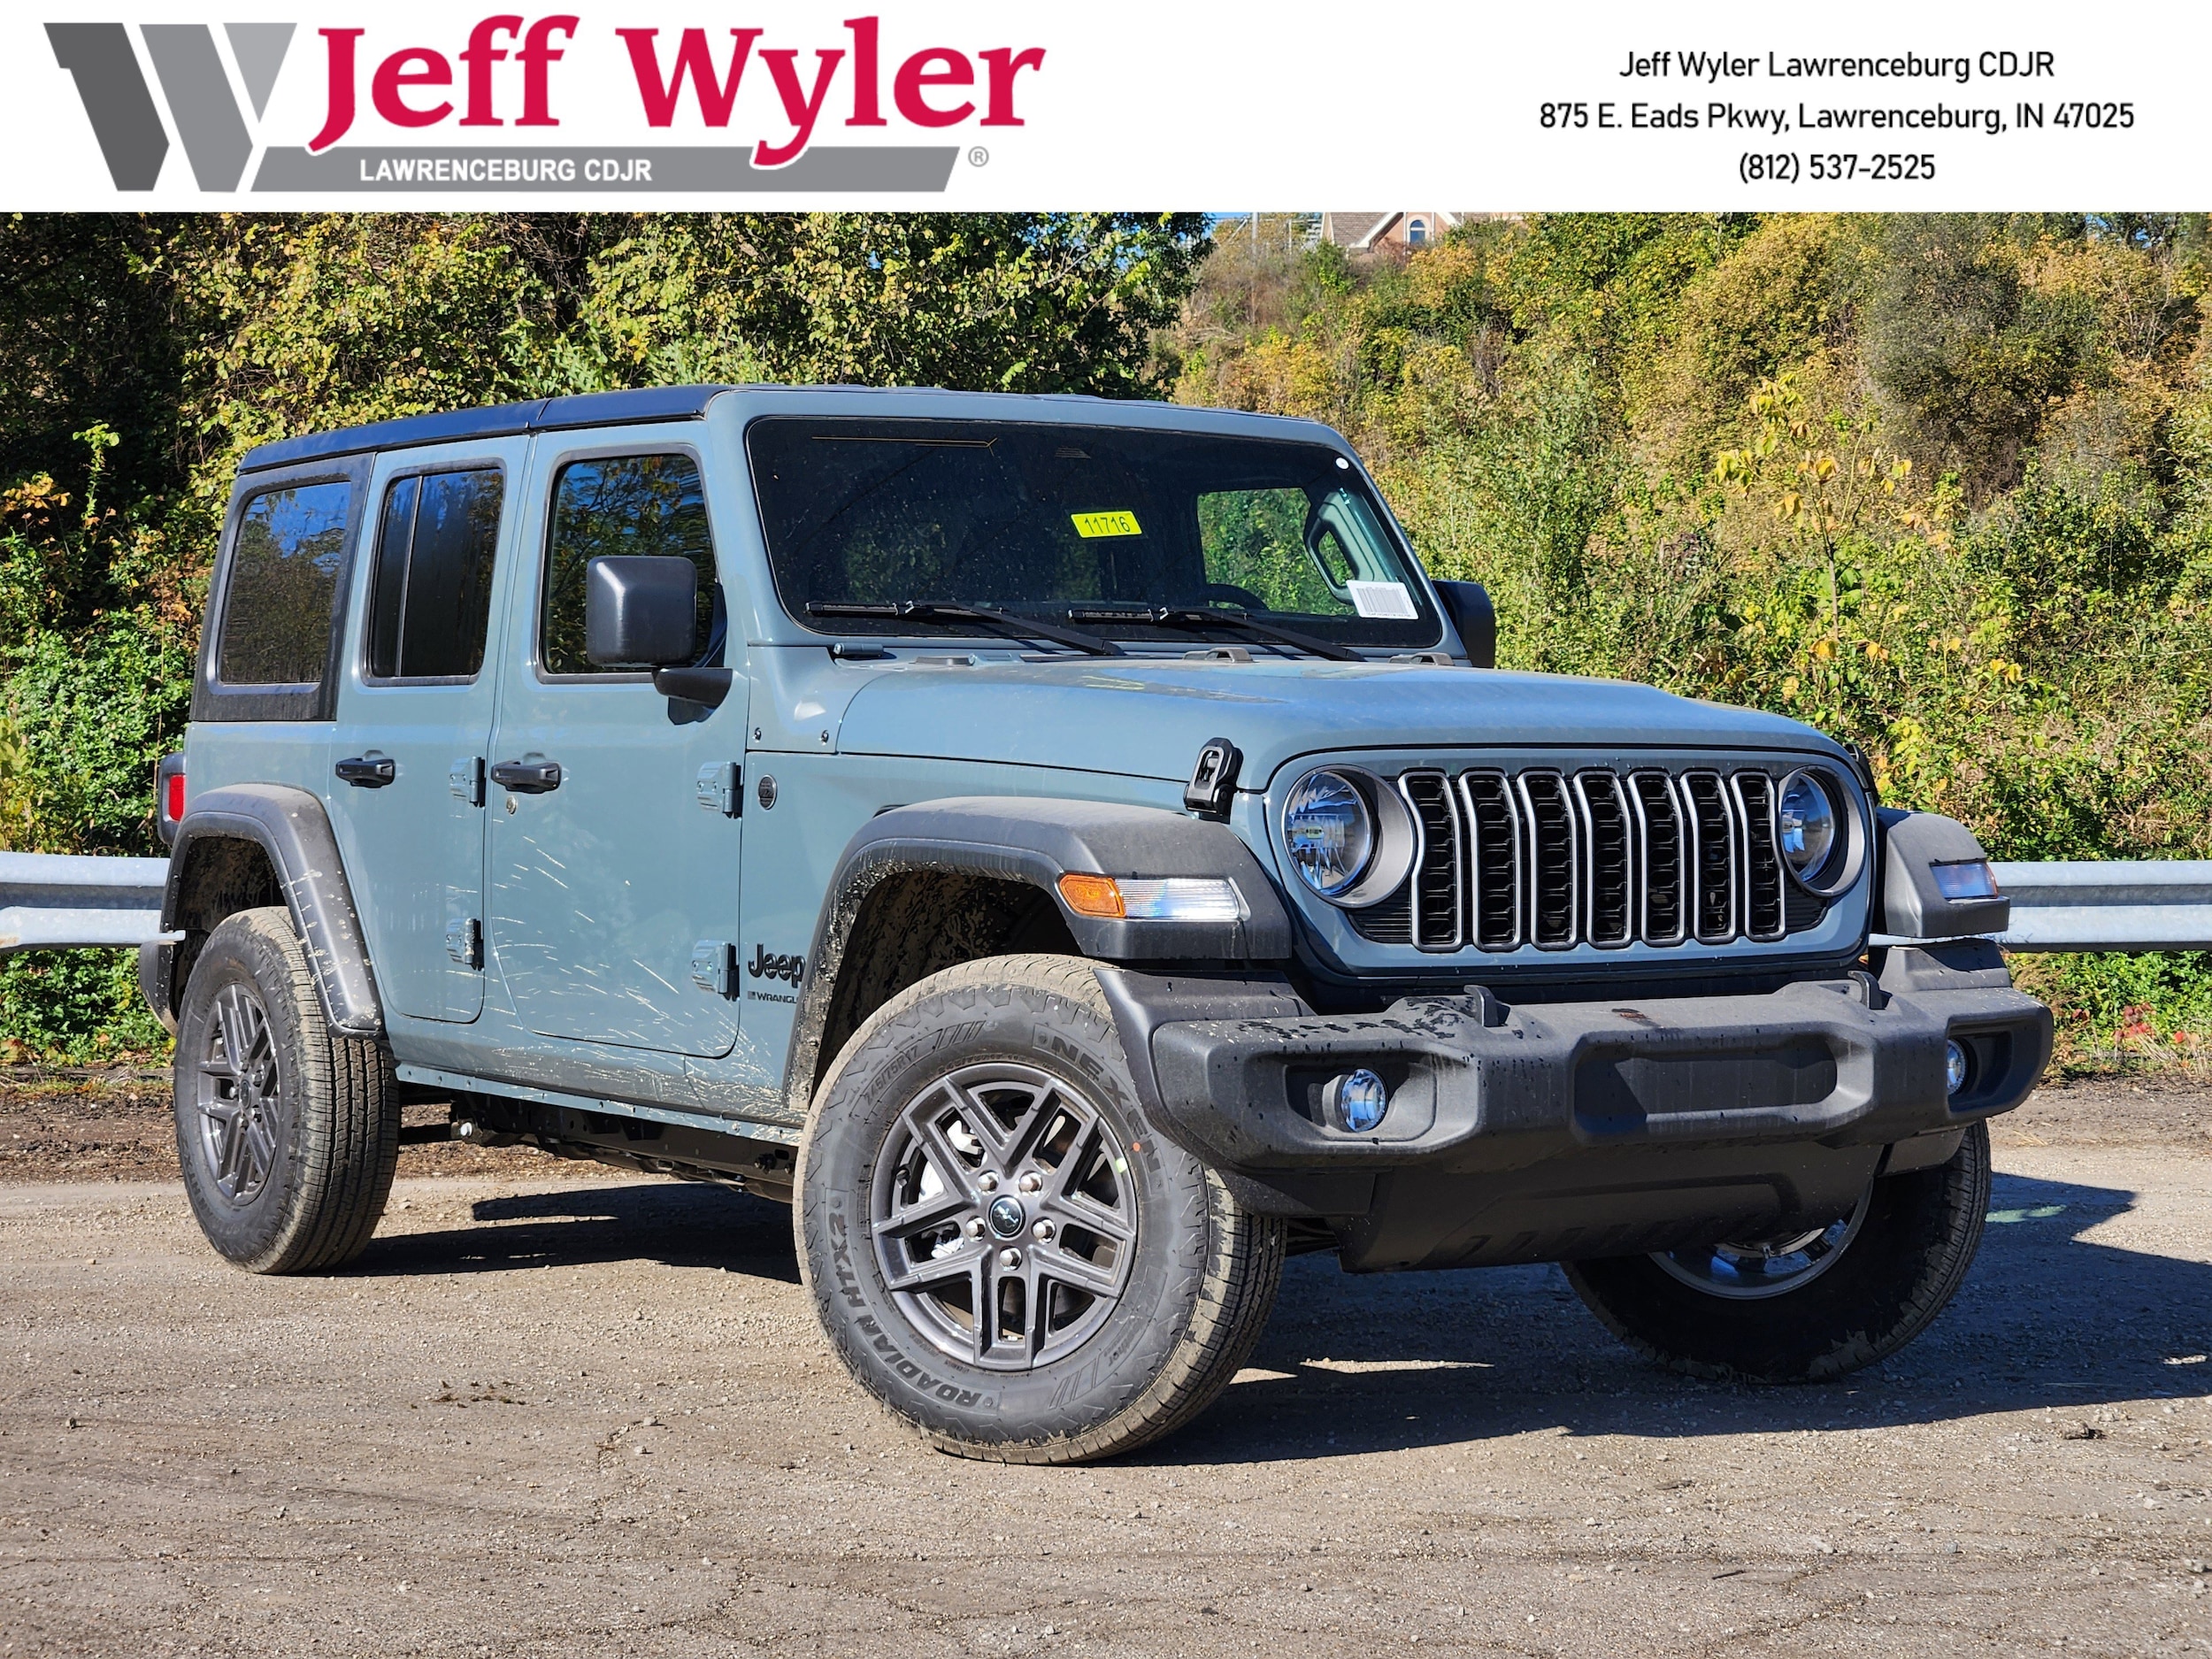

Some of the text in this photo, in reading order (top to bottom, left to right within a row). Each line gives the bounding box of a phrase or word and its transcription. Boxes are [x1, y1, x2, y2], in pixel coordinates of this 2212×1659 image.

[1085, 517, 1131, 534] 11716
[748, 943, 806, 988] Jeep
[757, 992, 799, 1004] WRANGL
[828, 1213, 983, 1408] ROADIAN HTX2
